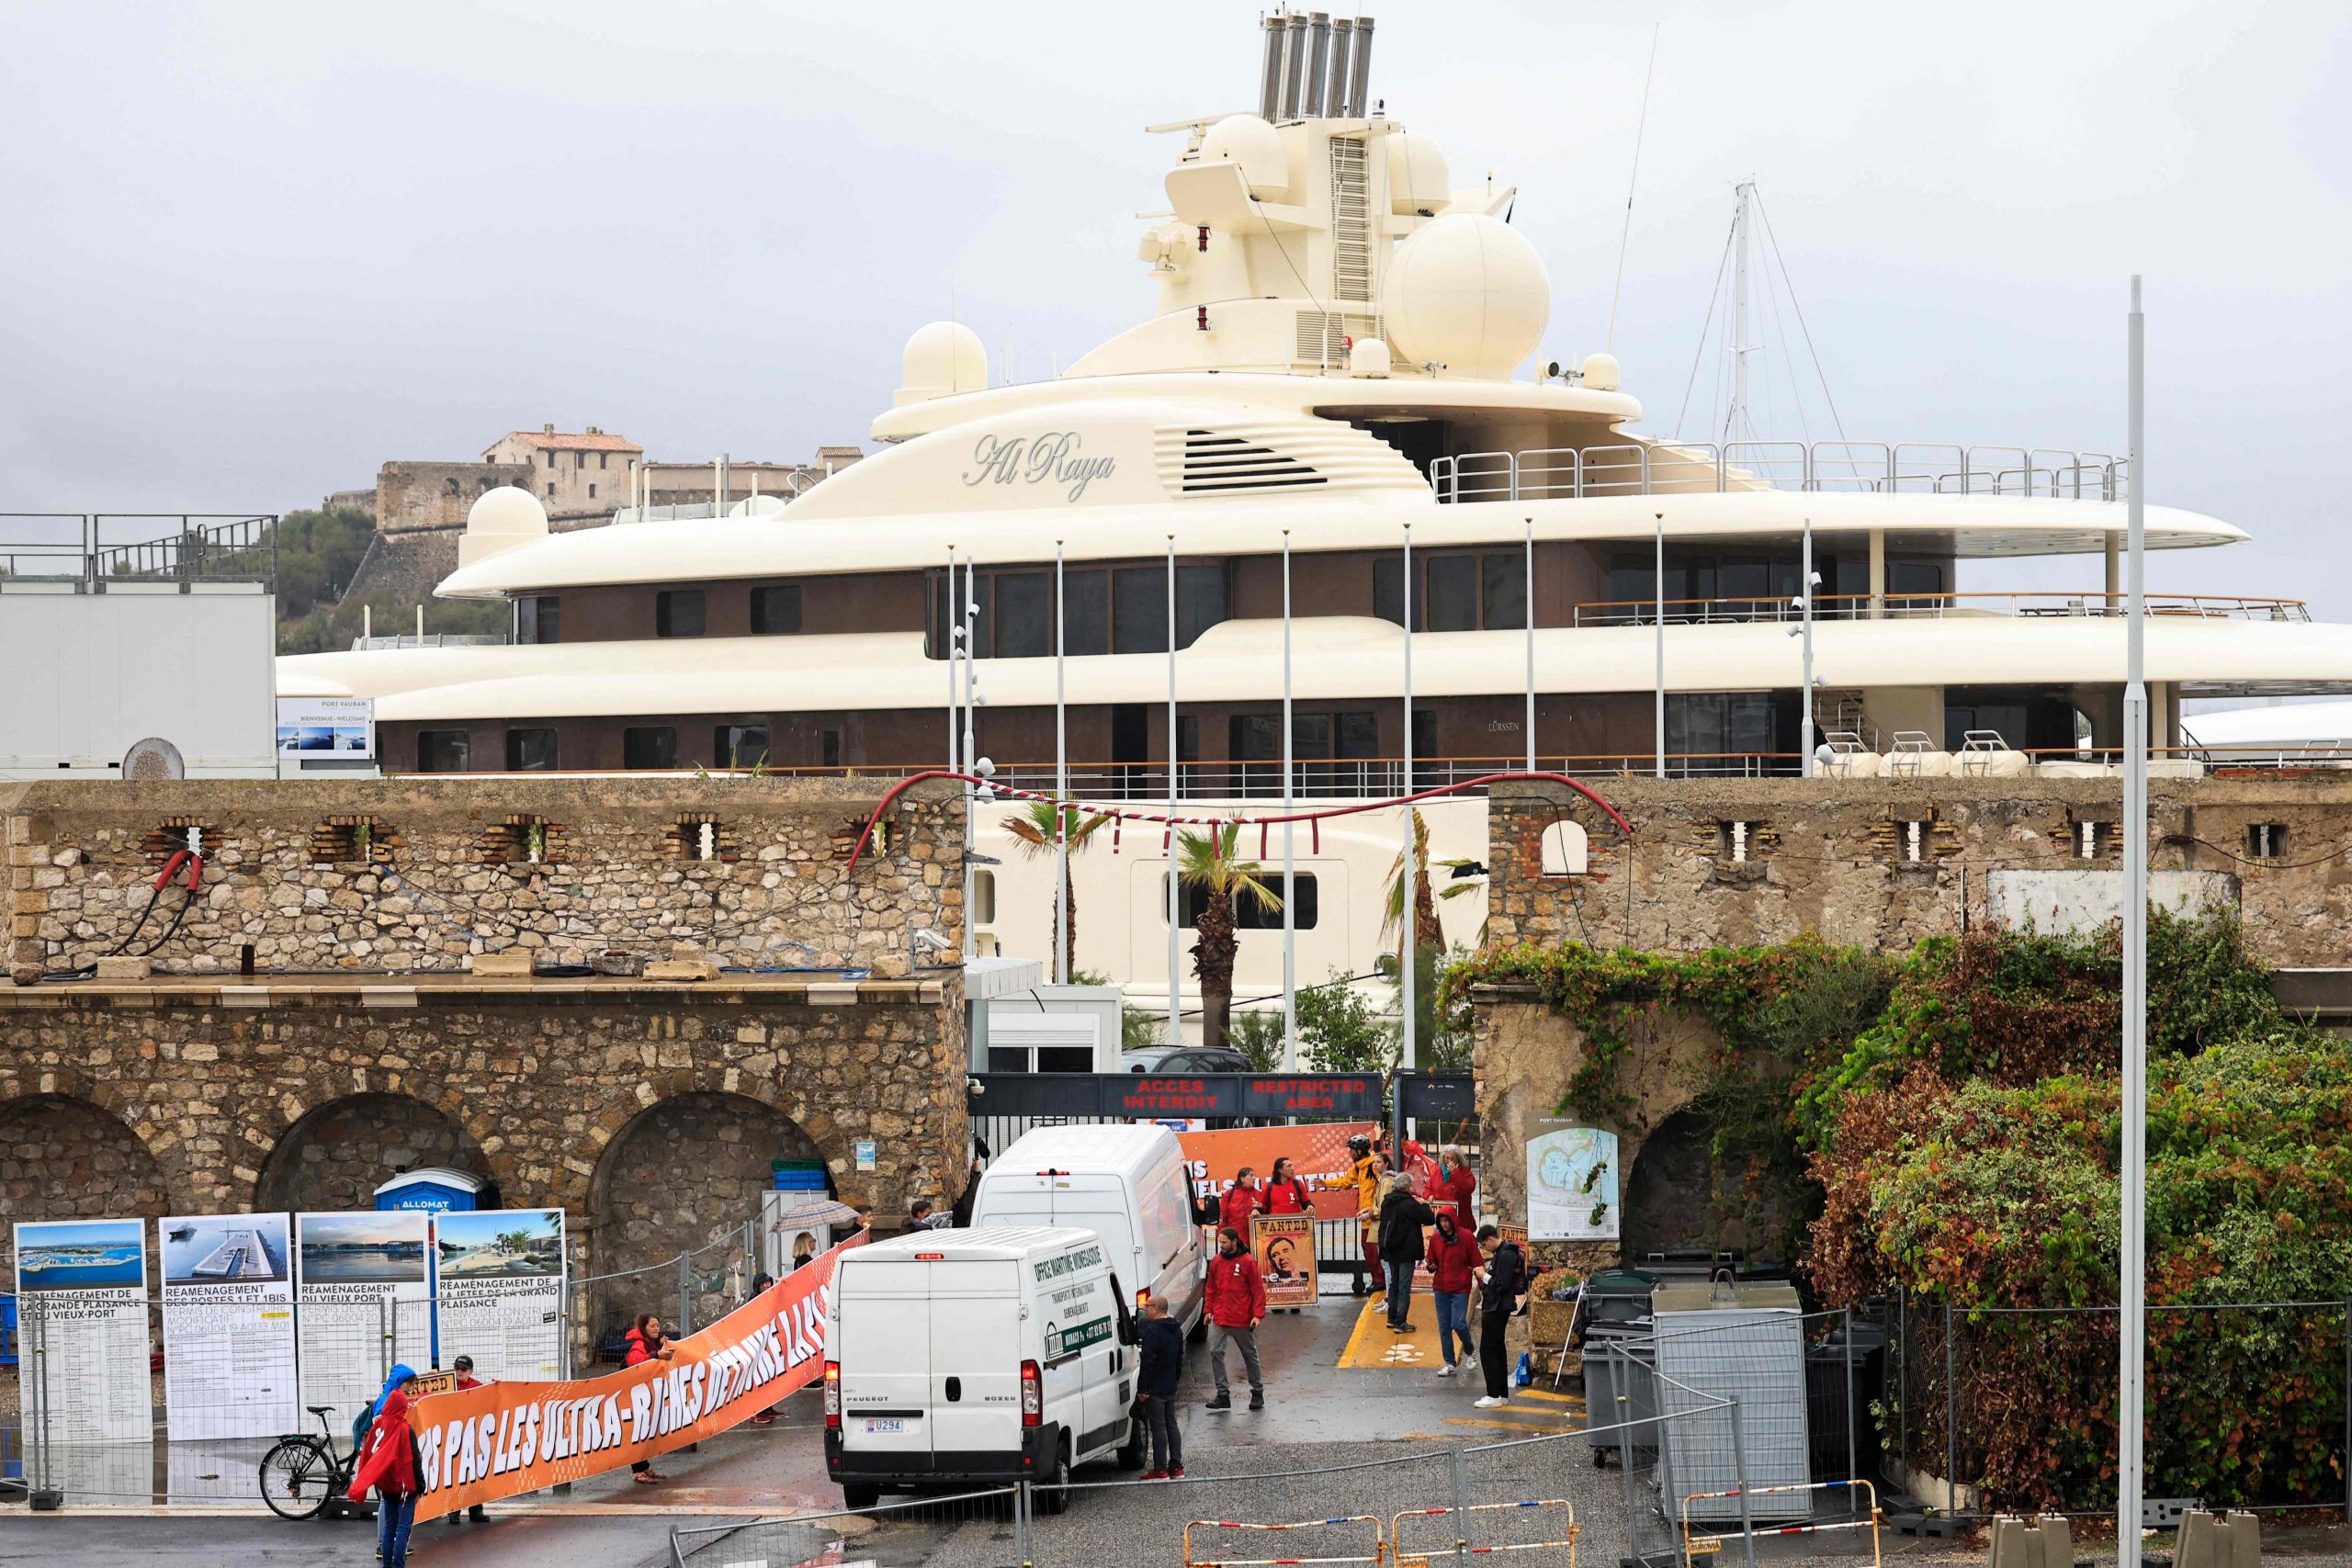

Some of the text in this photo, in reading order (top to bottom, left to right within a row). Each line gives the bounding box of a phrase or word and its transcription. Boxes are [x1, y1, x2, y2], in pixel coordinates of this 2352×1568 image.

[962, 432, 1116, 502] Al Raya
[1488, 720, 1520, 732] LÜRSSEN
[1137, 1079, 1204, 1093] ACCES
[1252, 1079, 1367, 1094] RESTRICTED
[1124, 1095, 1219, 1110] INTERDIT
[1285, 1096, 1334, 1110] AREA
[1260, 1220, 1308, 1232] WANTED
[1034, 1260, 1053, 1282] OFFICE
[166, 1284, 266, 1297] RÉAMÉNAGEMENT
[302, 1282, 397, 1293] RÉAMÉNAGEMENT
[440, 1278, 551, 1290] RÉAMÉNAGEMENT DE
[118, 1290, 131, 1299] DE
[302, 1293, 381, 1303] DU VIEUX PORT
[519, 1287, 558, 1297] GRAND
[36, 1301, 80, 1311] GRANDE
[84, 1298, 141, 1309] PLAISANCE
[166, 1296, 187, 1307] DES
[264, 1293, 287, 1303] 1BIS
[441, 1299, 498, 1309] PLAISANCE
[53, 1309, 116, 1320] VIEUX-PORT
[167, 1303, 287, 1316] PERMIS DE CONSTRUIRE
[302, 1304, 339, 1314] PERMIS
[342, 1304, 356, 1313] DE
[441, 1306, 557, 1319] PERMIS DE CONSTRUIR
[167, 1314, 232, 1325] MODIFICATIF
[406, 1377, 448, 1395] NTED
[444, 1413, 496, 1488] PAS
[493, 1402, 540, 1475] LES
[540, 1360, 707, 1462] ULTRA-RICHES
[787, 1303, 818, 1368] LA
[876, 1420, 900, 1430] U294
